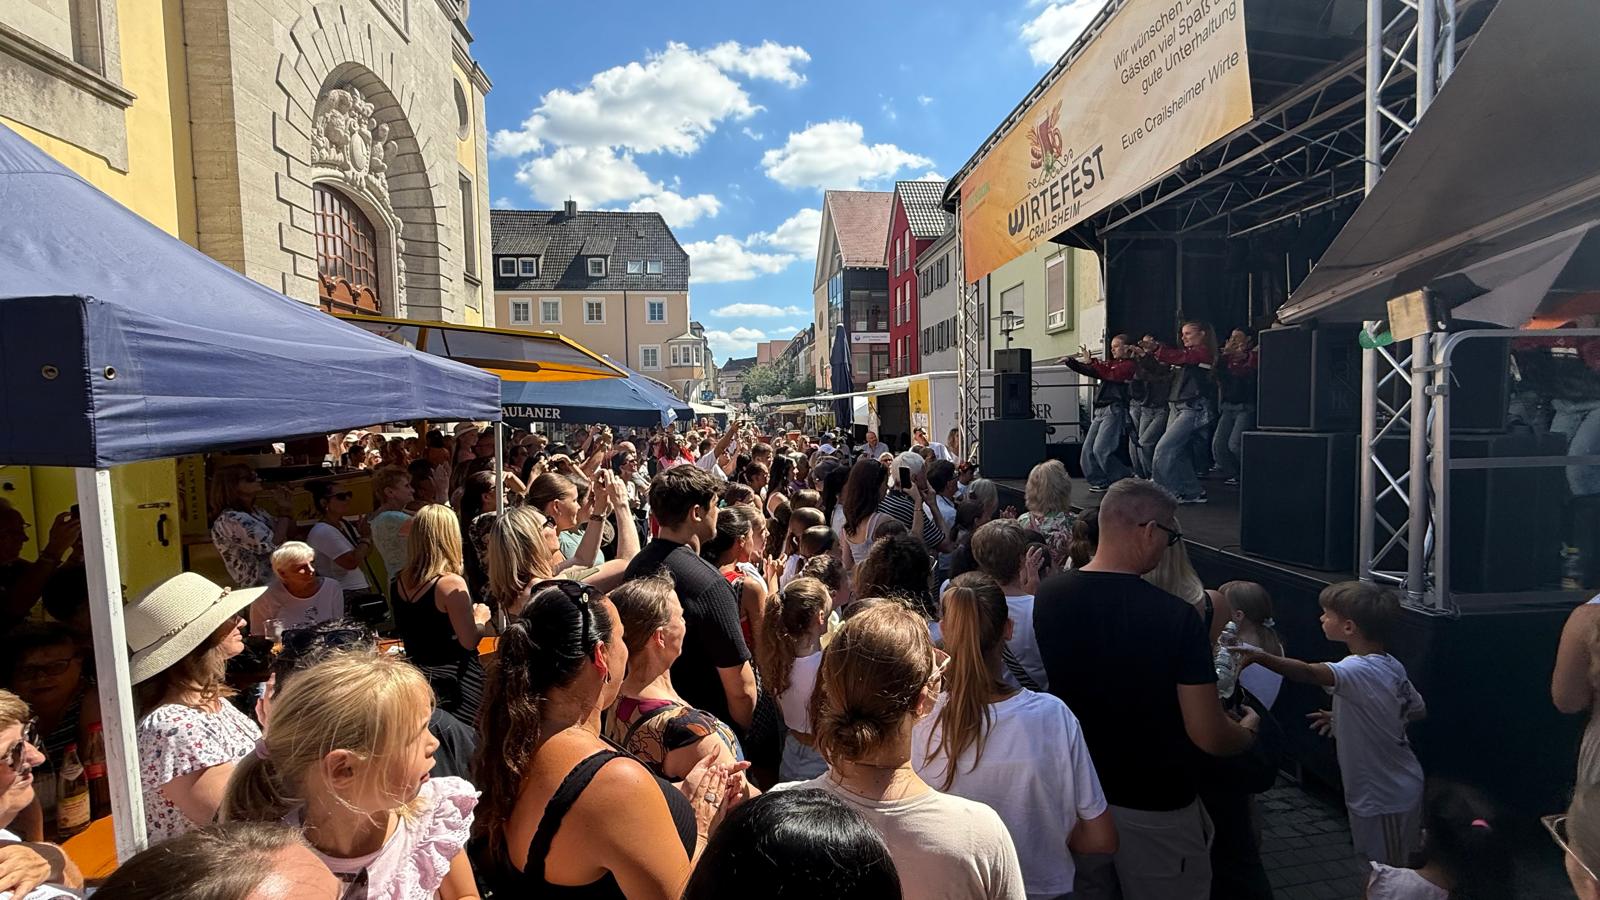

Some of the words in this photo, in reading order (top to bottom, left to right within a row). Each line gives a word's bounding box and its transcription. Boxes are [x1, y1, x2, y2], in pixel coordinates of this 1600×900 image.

[1113, 48, 1128, 71] Wir
[1130, 0, 1183, 55] wünschen
[1120, 49, 1157, 85] Gästen
[1158, 27, 1176, 54] viel
[1178, 0, 1211, 36] Spaß
[1141, 67, 1163, 95] gute
[1165, 0, 1237, 72] Unterhaltung
[1121, 127, 1144, 150] Eure
[1144, 77, 1206, 133] Crailsheimer
[1208, 51, 1239, 85] Wirte
[1008, 144, 1105, 237] WIRTEFEST
[1029, 201, 1081, 242] CRAILSHEIM
[501, 406, 561, 419] AULANER
